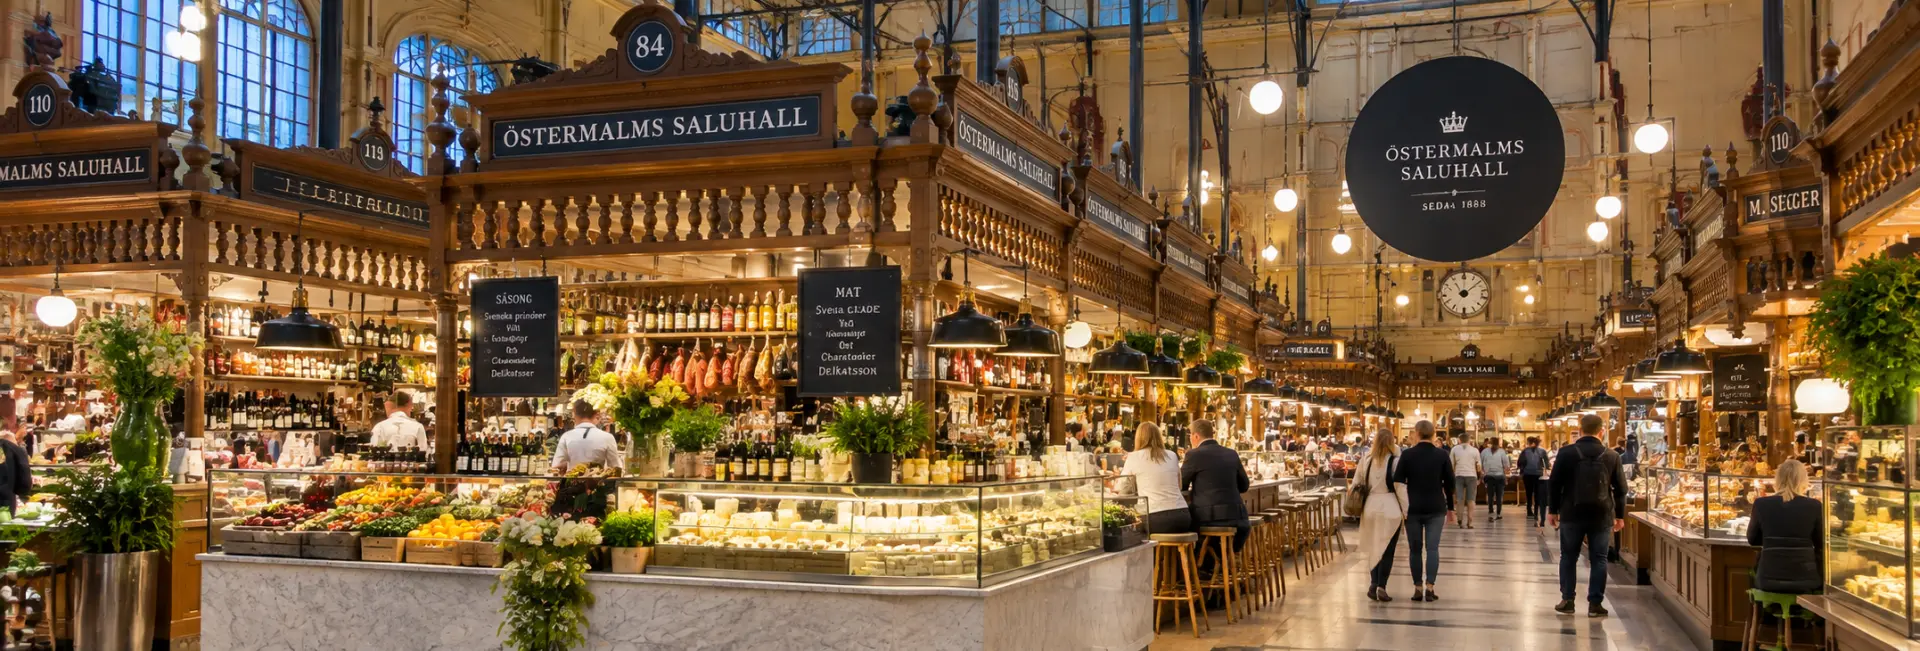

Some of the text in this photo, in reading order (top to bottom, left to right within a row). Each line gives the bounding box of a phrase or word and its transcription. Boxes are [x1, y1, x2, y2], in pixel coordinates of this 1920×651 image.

[635, 33, 665, 58] 84
[30, 94, 51, 114] 110
[503, 107, 808, 148] ÖSTERMALMS SALUHALL
[364, 143, 384, 161] 119
[1771, 132, 1789, 153] 110
[57, 155, 145, 178] SALUHALL
[1385, 139, 1525, 181] ÖSTERMALMS SALUHALL
[835, 286, 862, 298] MAT
